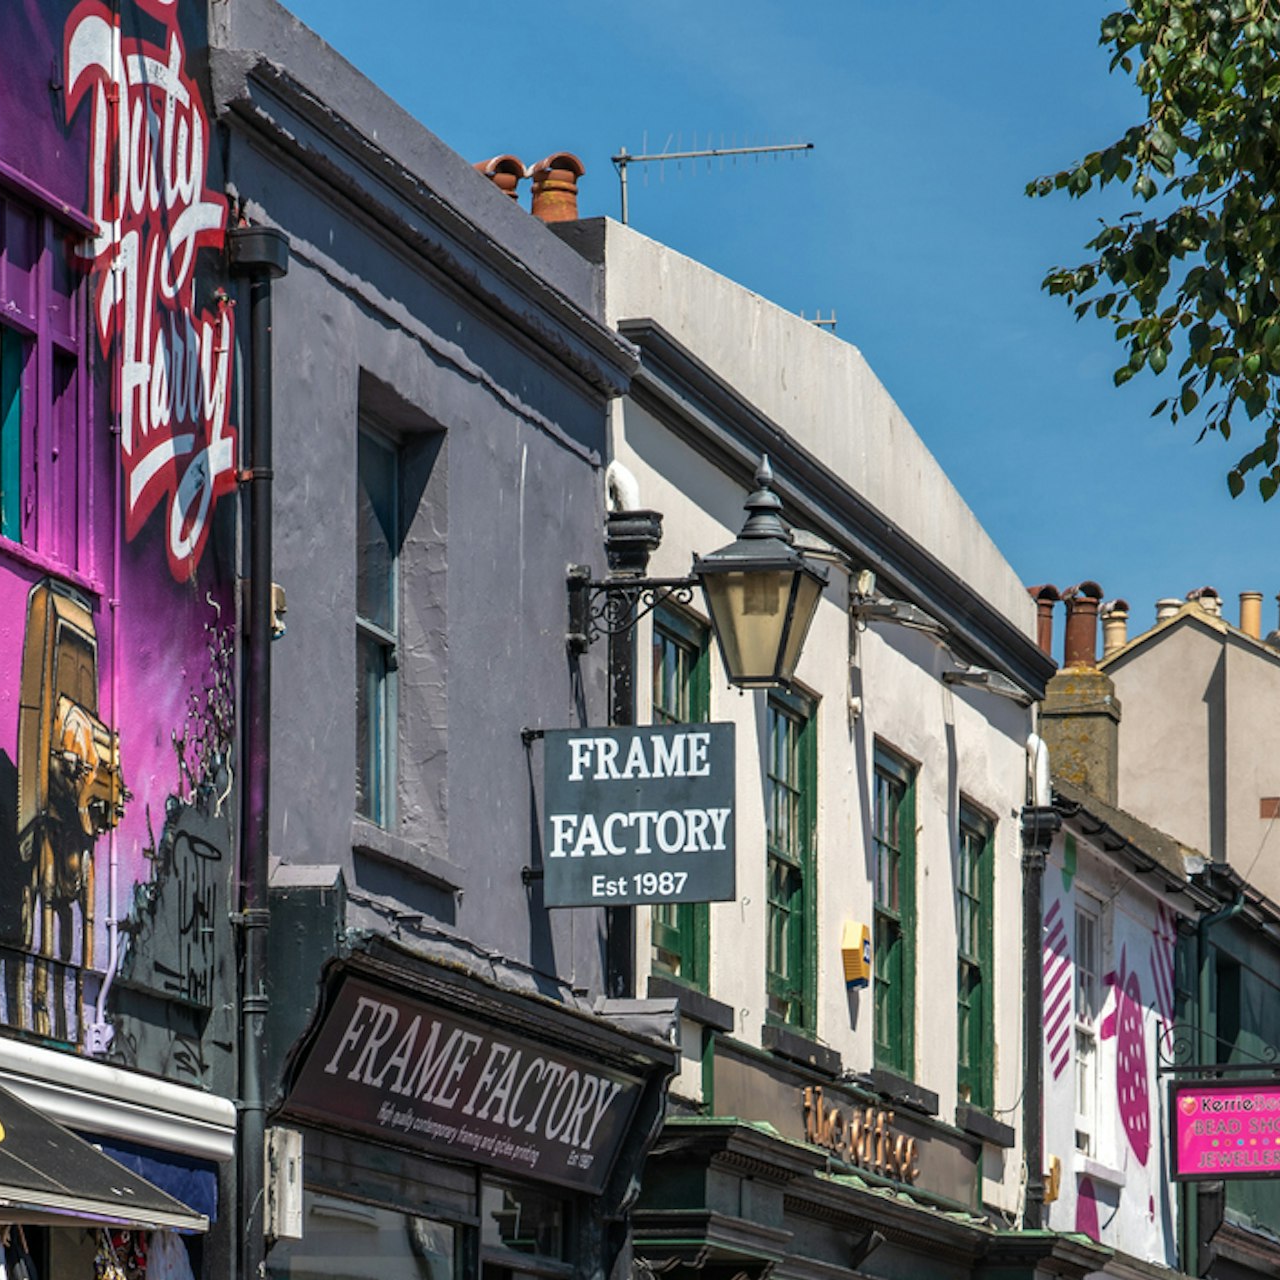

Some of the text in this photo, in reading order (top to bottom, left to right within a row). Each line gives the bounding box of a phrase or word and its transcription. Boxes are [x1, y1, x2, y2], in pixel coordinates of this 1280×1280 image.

[567, 732, 711, 782] FRAME
[549, 807, 732, 858] FACTORY
[591, 871, 688, 897] Est 1987
[323, 996, 624, 1151] FRAME FACTORY
[1193, 1118, 1242, 1136] BEAD
